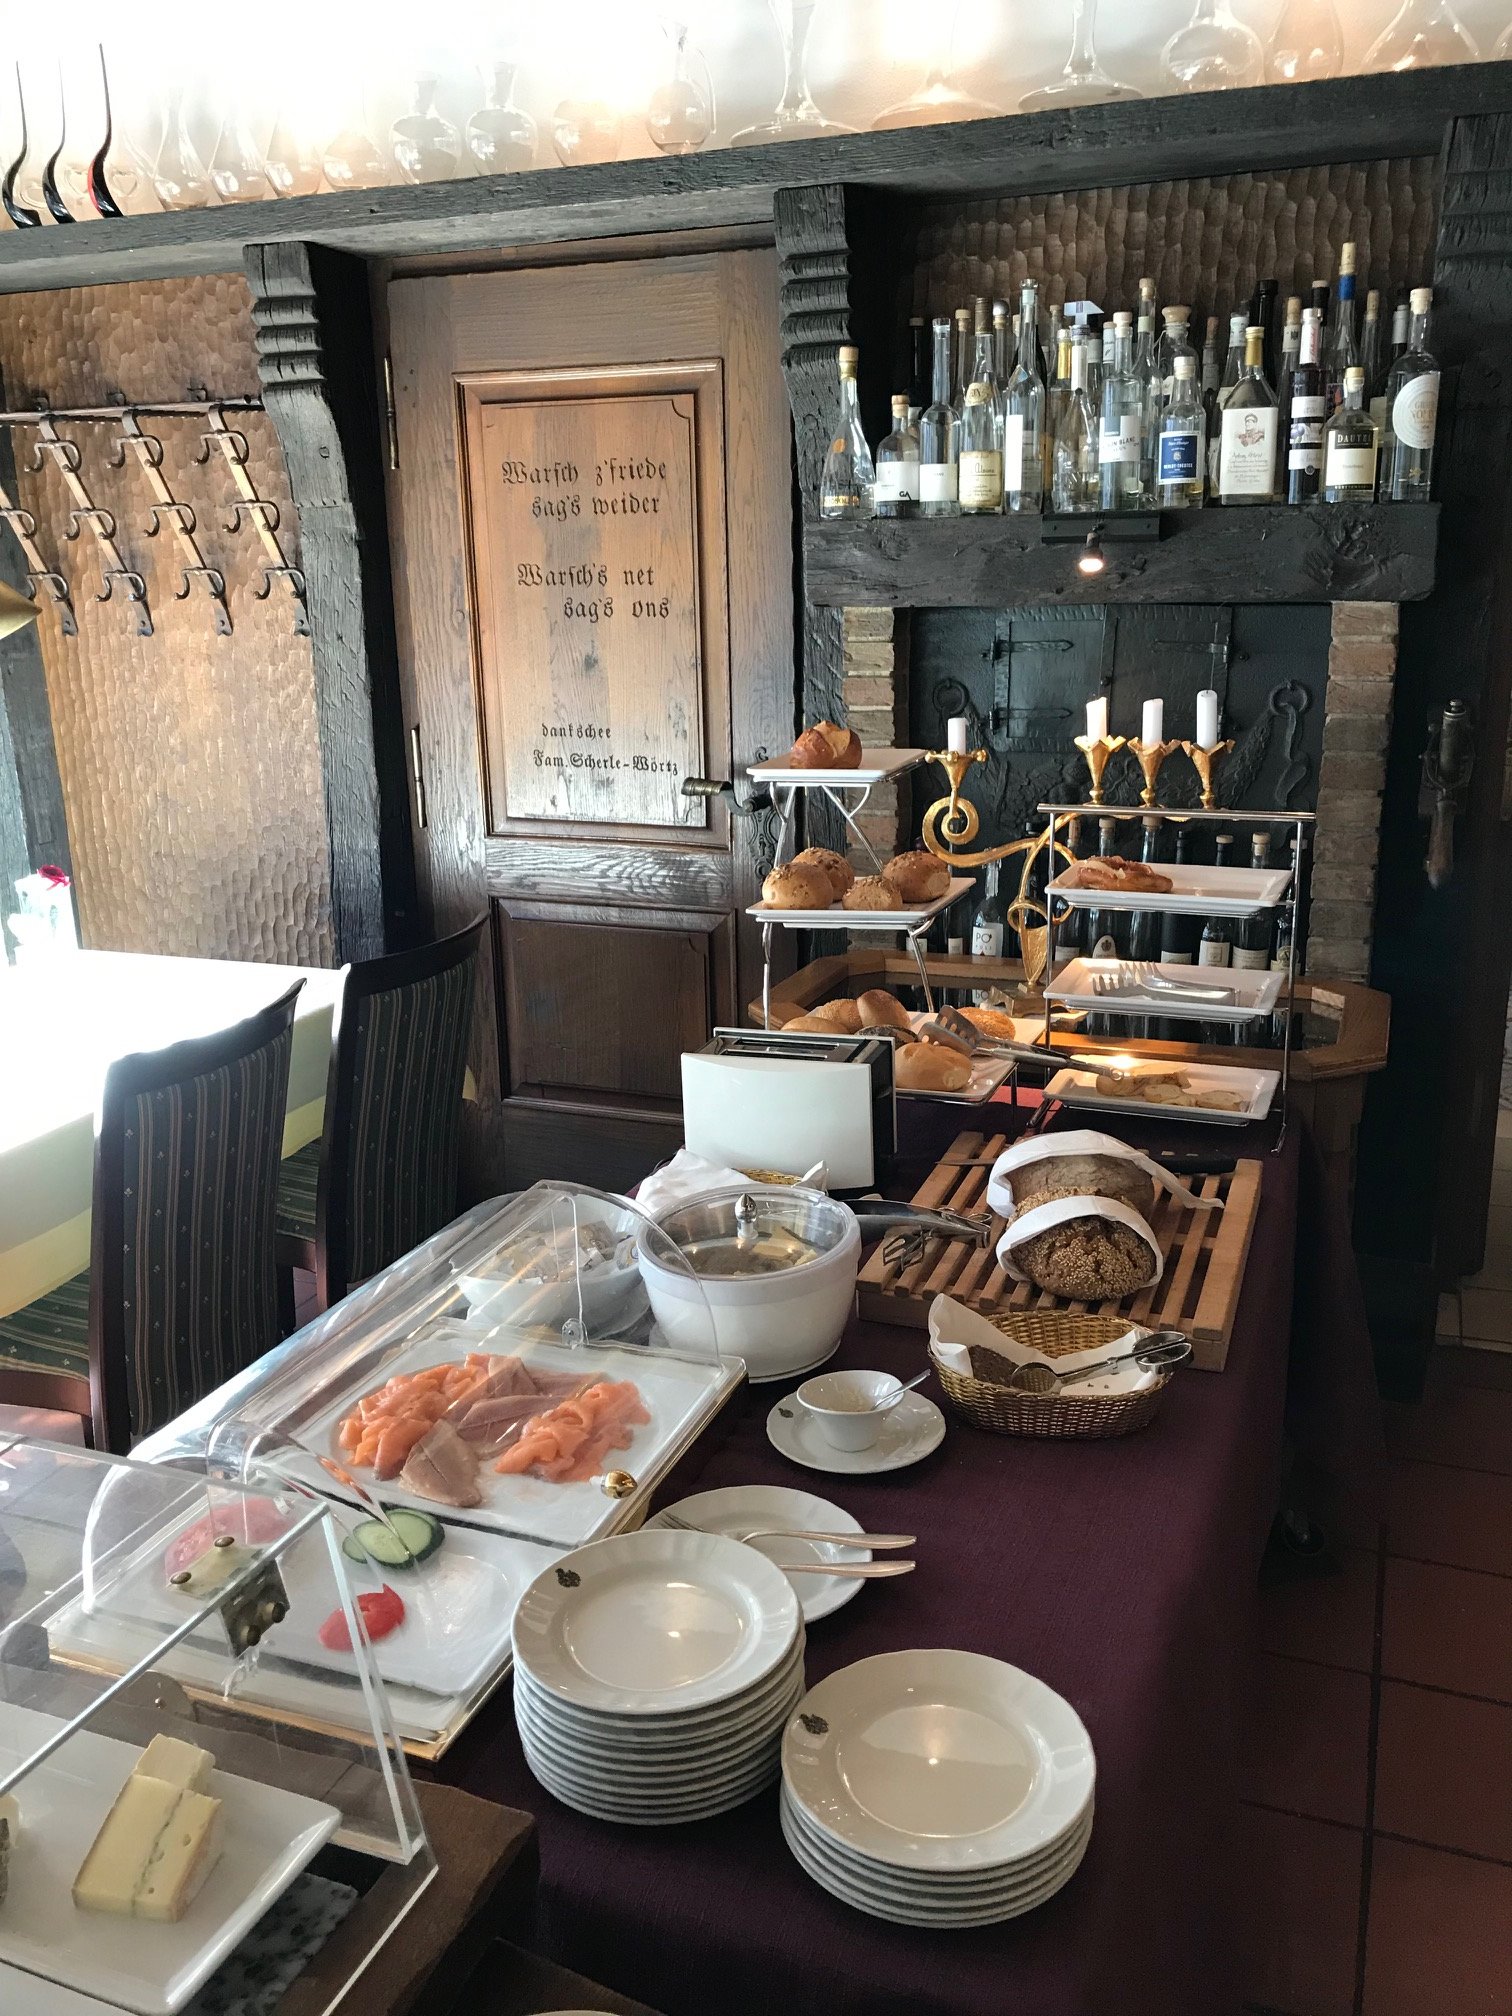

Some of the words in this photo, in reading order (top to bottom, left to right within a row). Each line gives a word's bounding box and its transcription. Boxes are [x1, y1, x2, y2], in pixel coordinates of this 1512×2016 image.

[532, 494, 581, 522] sag's
[592, 491, 660, 516] weider
[623, 565, 654, 587] net
[564, 597, 614, 624] sag's
[632, 597, 670, 619] ons
